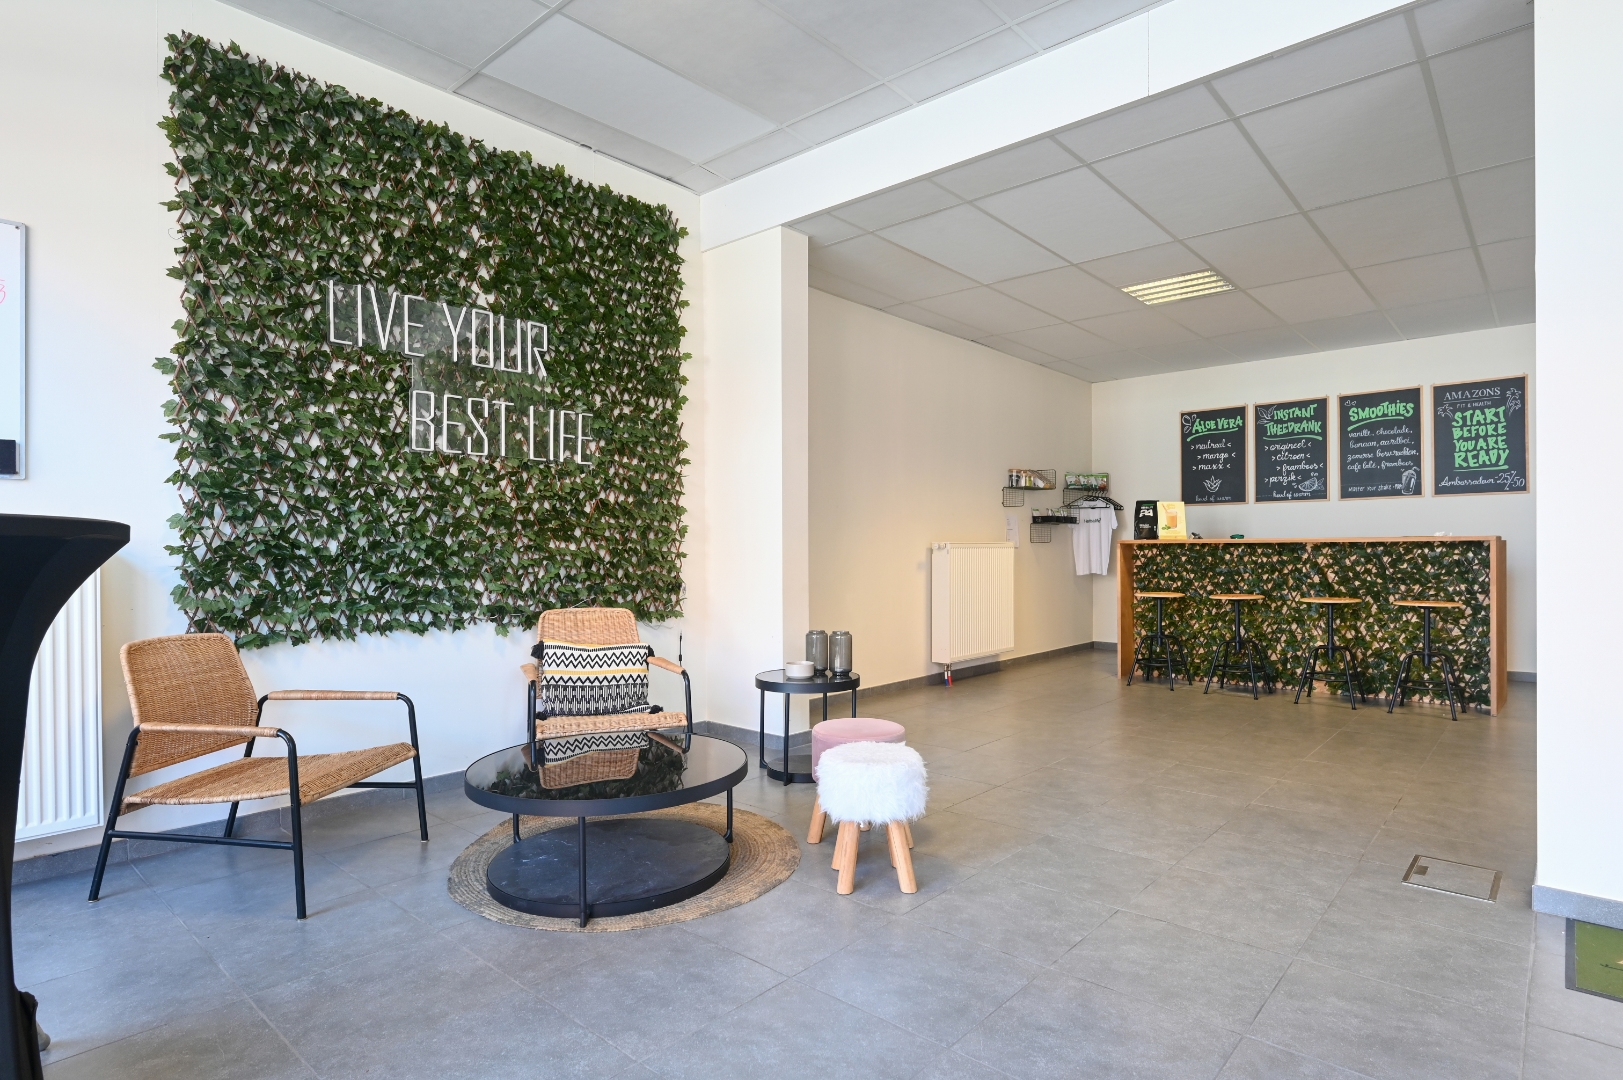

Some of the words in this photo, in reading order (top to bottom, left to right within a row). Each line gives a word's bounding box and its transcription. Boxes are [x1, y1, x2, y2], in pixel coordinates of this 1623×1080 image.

[329, 279, 425, 357] LIVE
[442, 303, 548, 377] YOUR
[1443, 386, 1501, 401] AMAZONS
[1274, 404, 1317, 420] INSTANT
[1452, 406, 1506, 426] START
[412, 390, 514, 456] BEST
[530, 405, 594, 465] LIFE
[1192, 418, 1217, 433] ALOE
[1217, 415, 1243, 429] VERA
[1264, 420, 1322, 436] THEEDRANK
[1452, 422, 1507, 439] BEFORE
[1453, 439, 1475, 452] YOU
[1477, 436, 1508, 450] ARE
[1453, 448, 1509, 467] READY
